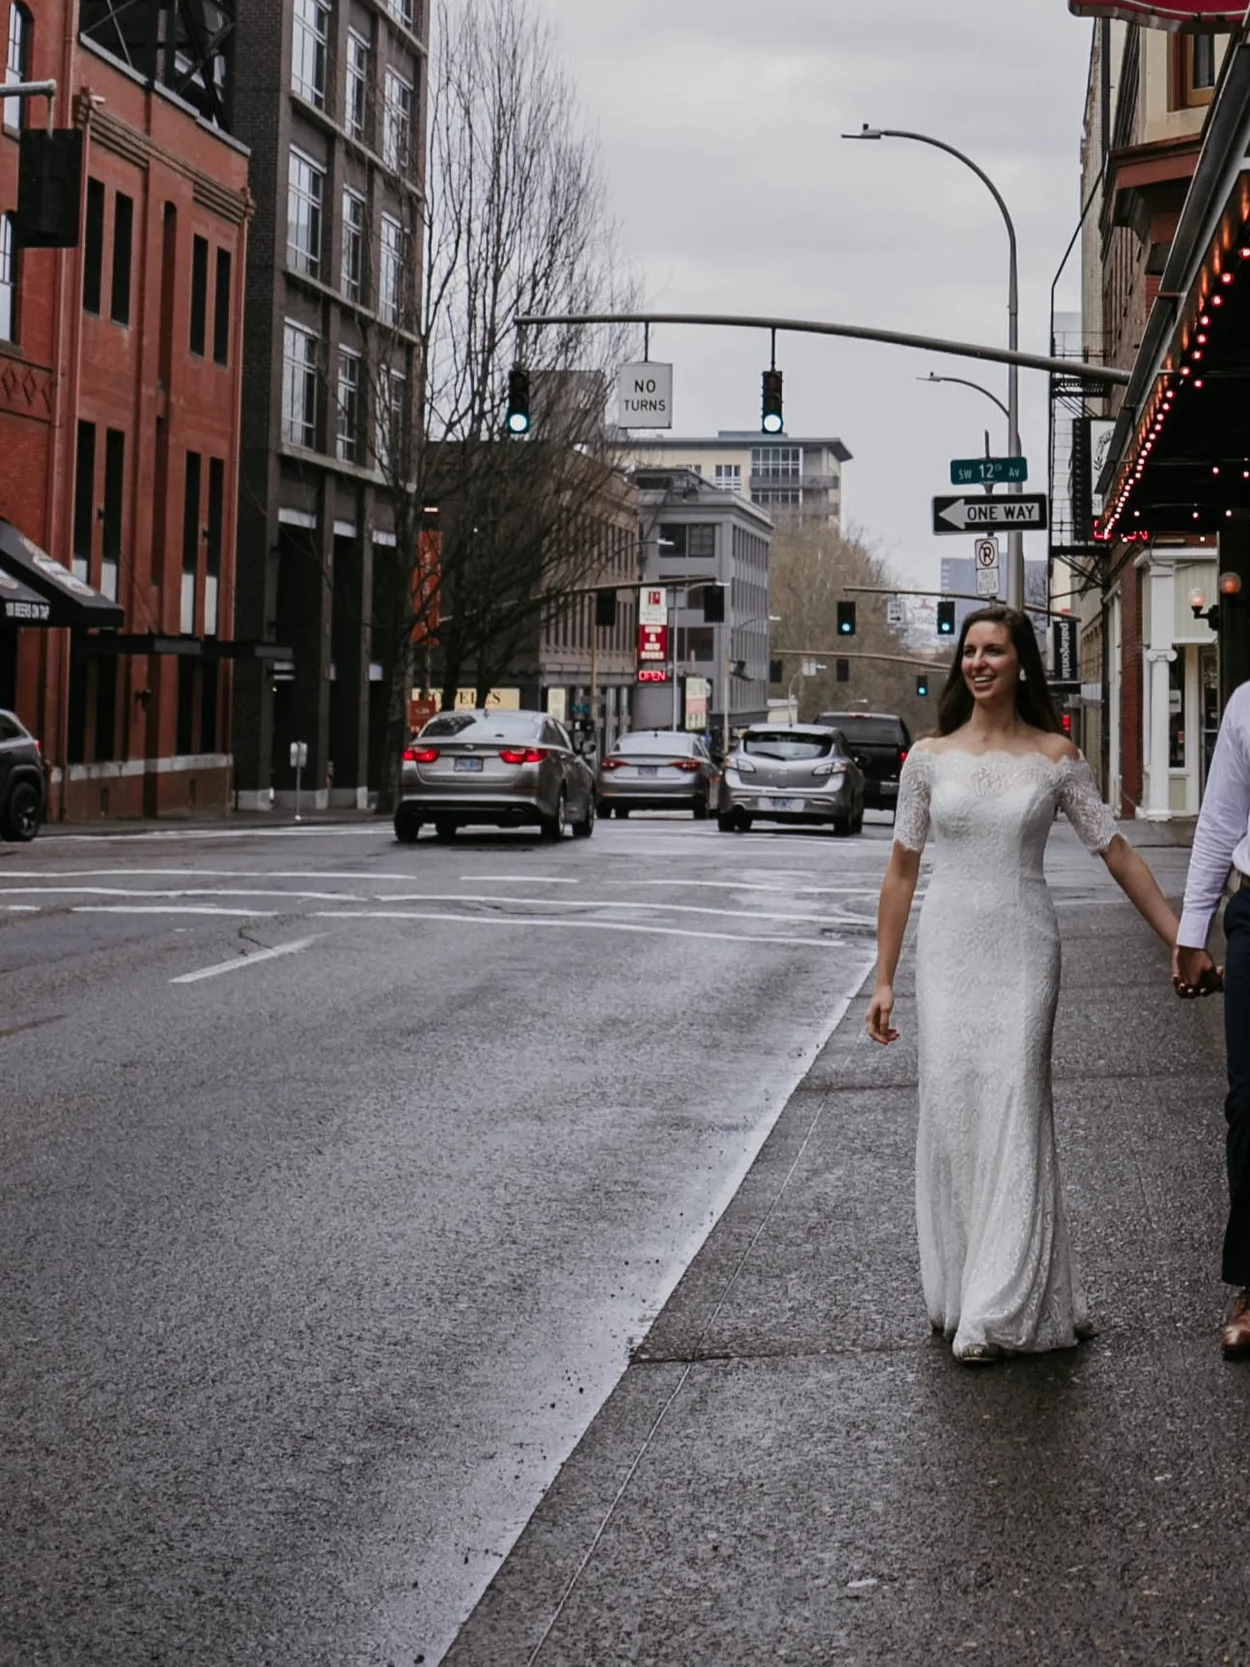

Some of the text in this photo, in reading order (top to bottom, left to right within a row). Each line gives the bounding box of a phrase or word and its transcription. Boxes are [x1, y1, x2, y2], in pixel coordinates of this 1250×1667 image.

[634, 379, 656, 394] NO
[624, 399, 666, 412] TURNS
[958, 468, 972, 480] SW
[967, 505, 1034, 521] ONE WAY
[1059, 622, 1071, 679] patagonia
[639, 670, 666, 681] OPEN
